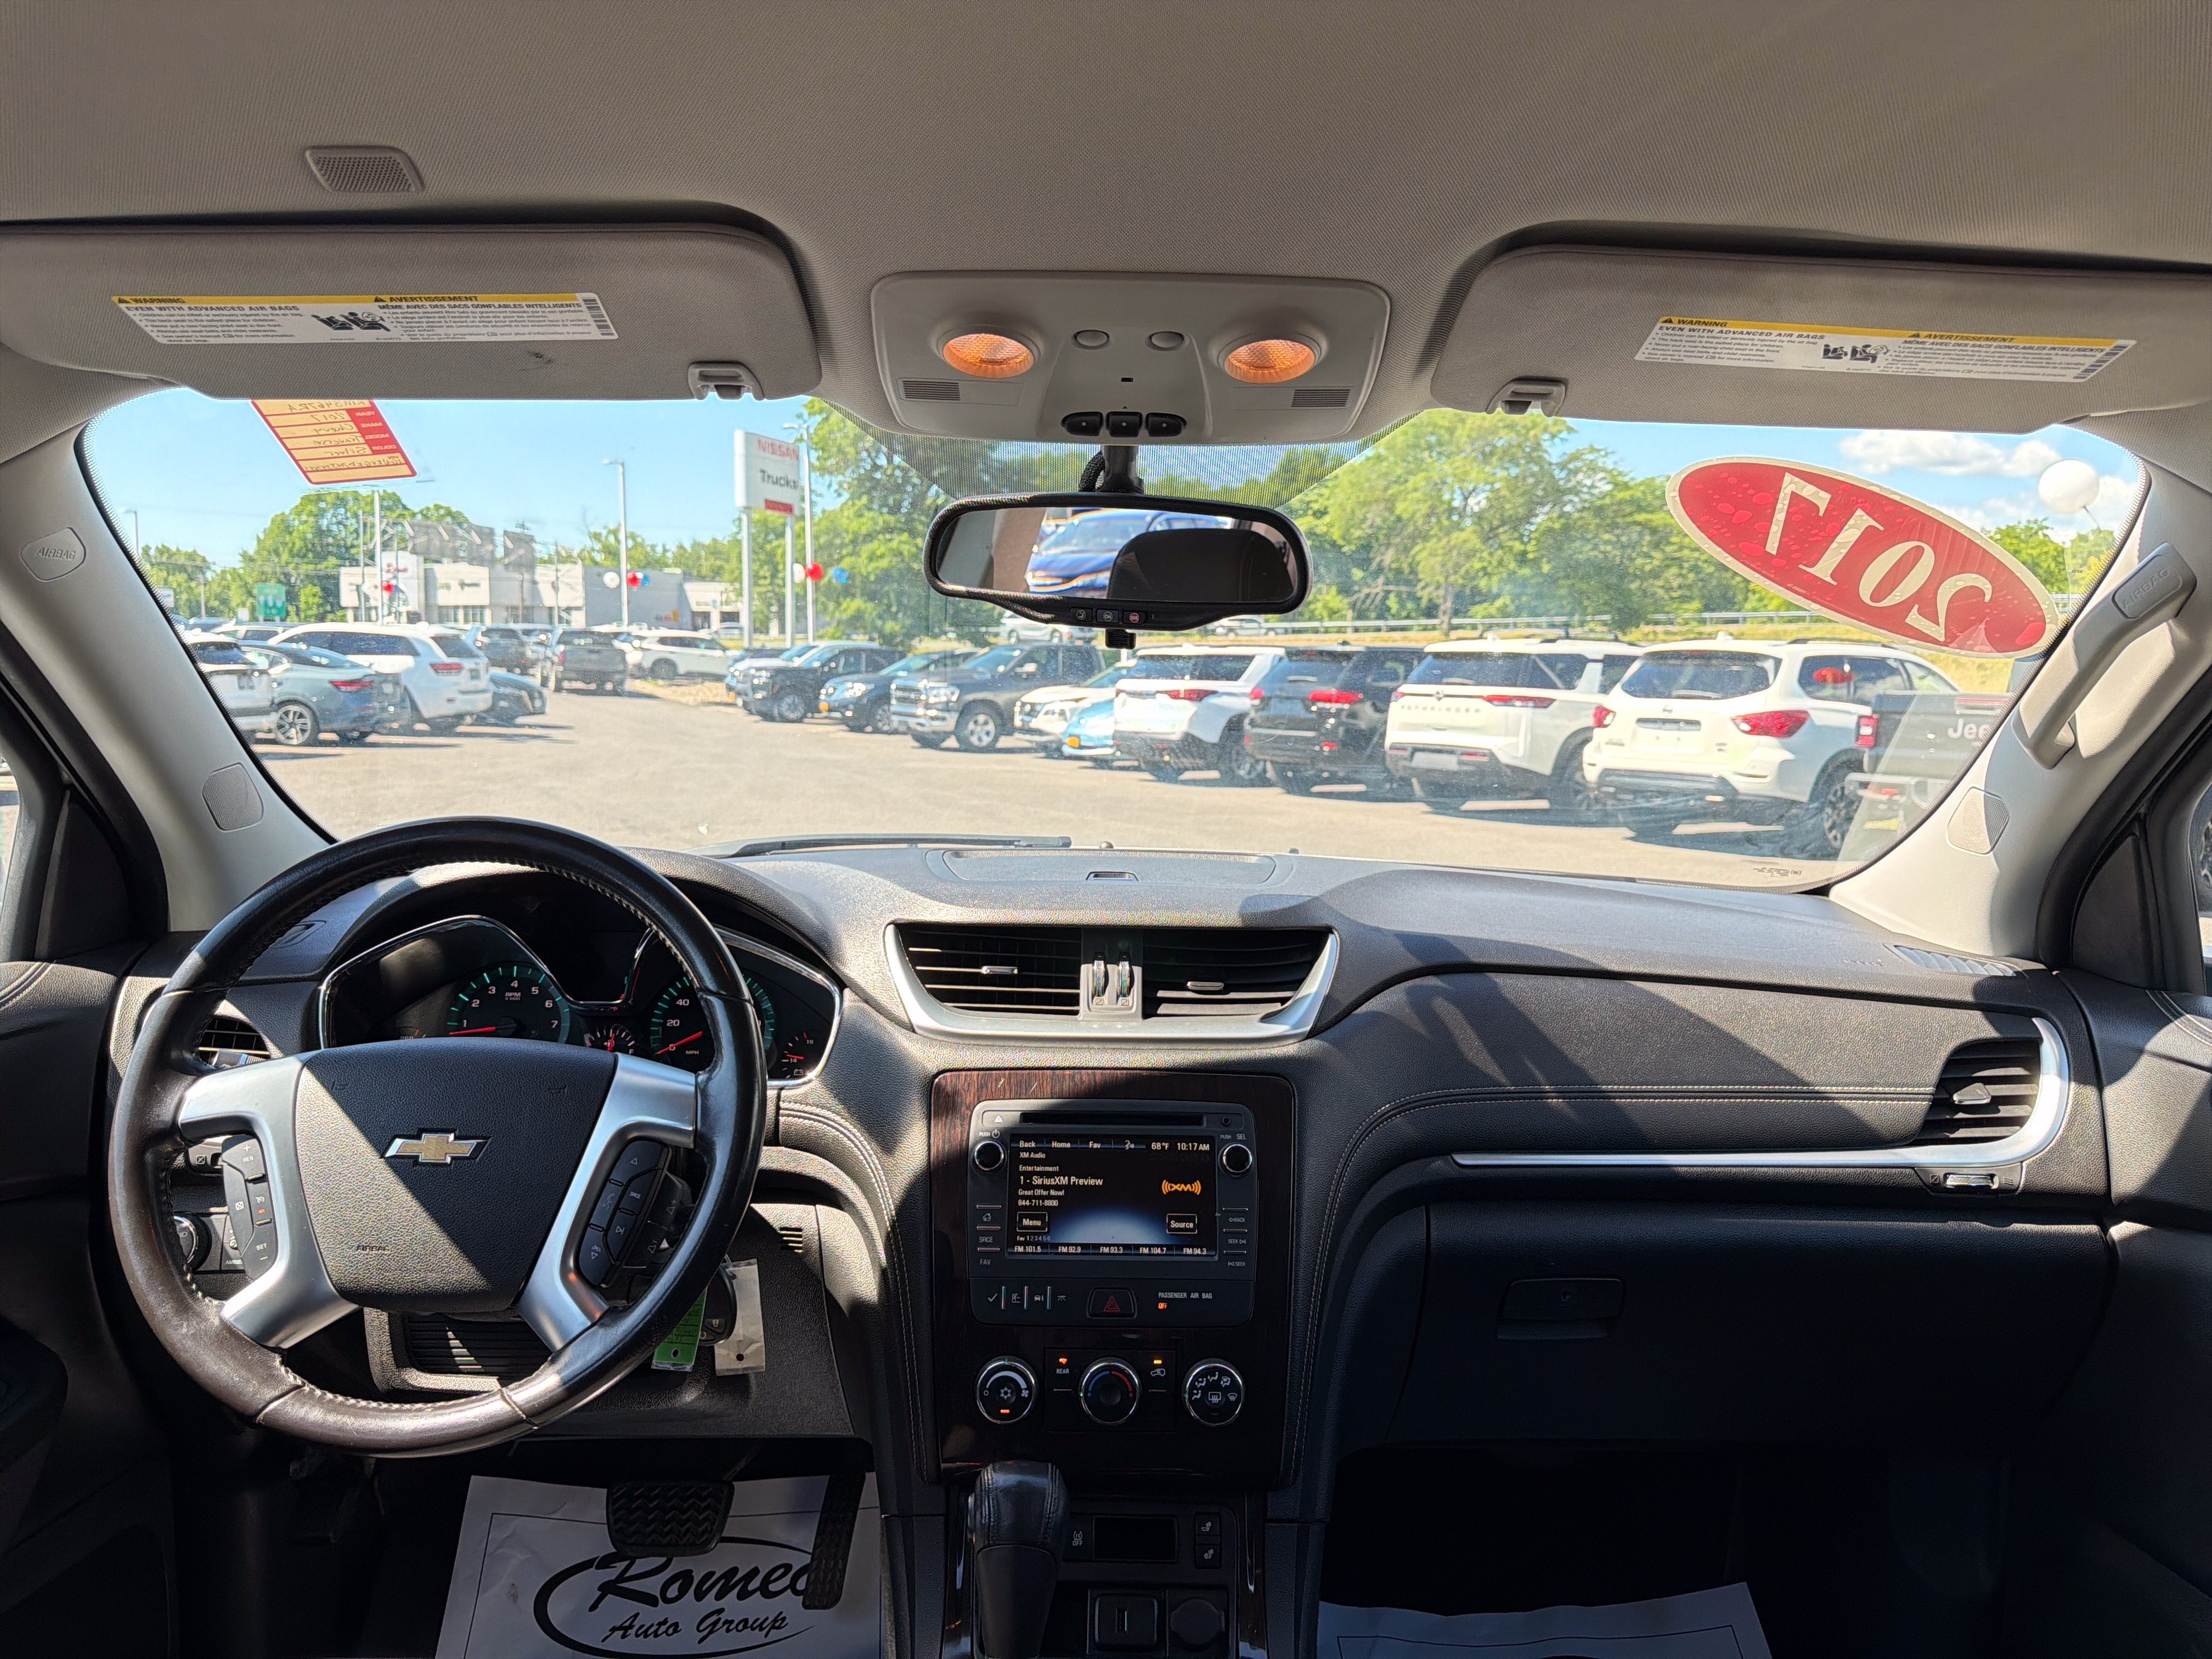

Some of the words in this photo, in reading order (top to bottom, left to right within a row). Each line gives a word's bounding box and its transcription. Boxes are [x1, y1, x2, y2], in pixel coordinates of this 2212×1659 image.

[1925, 334, 2015, 342] AVERTISSEMENT
[758, 439, 799, 460] NISSAN
[759, 469, 799, 490] Trucks
[35, 545, 76, 561] AIRBAG
[472, 999, 480, 1007] 2
[462, 1019, 467, 1028] 1
[1152, 1142, 1169, 1150] 68°F
[1020, 1176, 1024, 1184] 1
[1032, 1176, 1068, 1185] SiriusXM
[1070, 1176, 1103, 1186] Preview
[601, 1612, 682, 1643] Auto
[696, 1607, 788, 1645] Group
